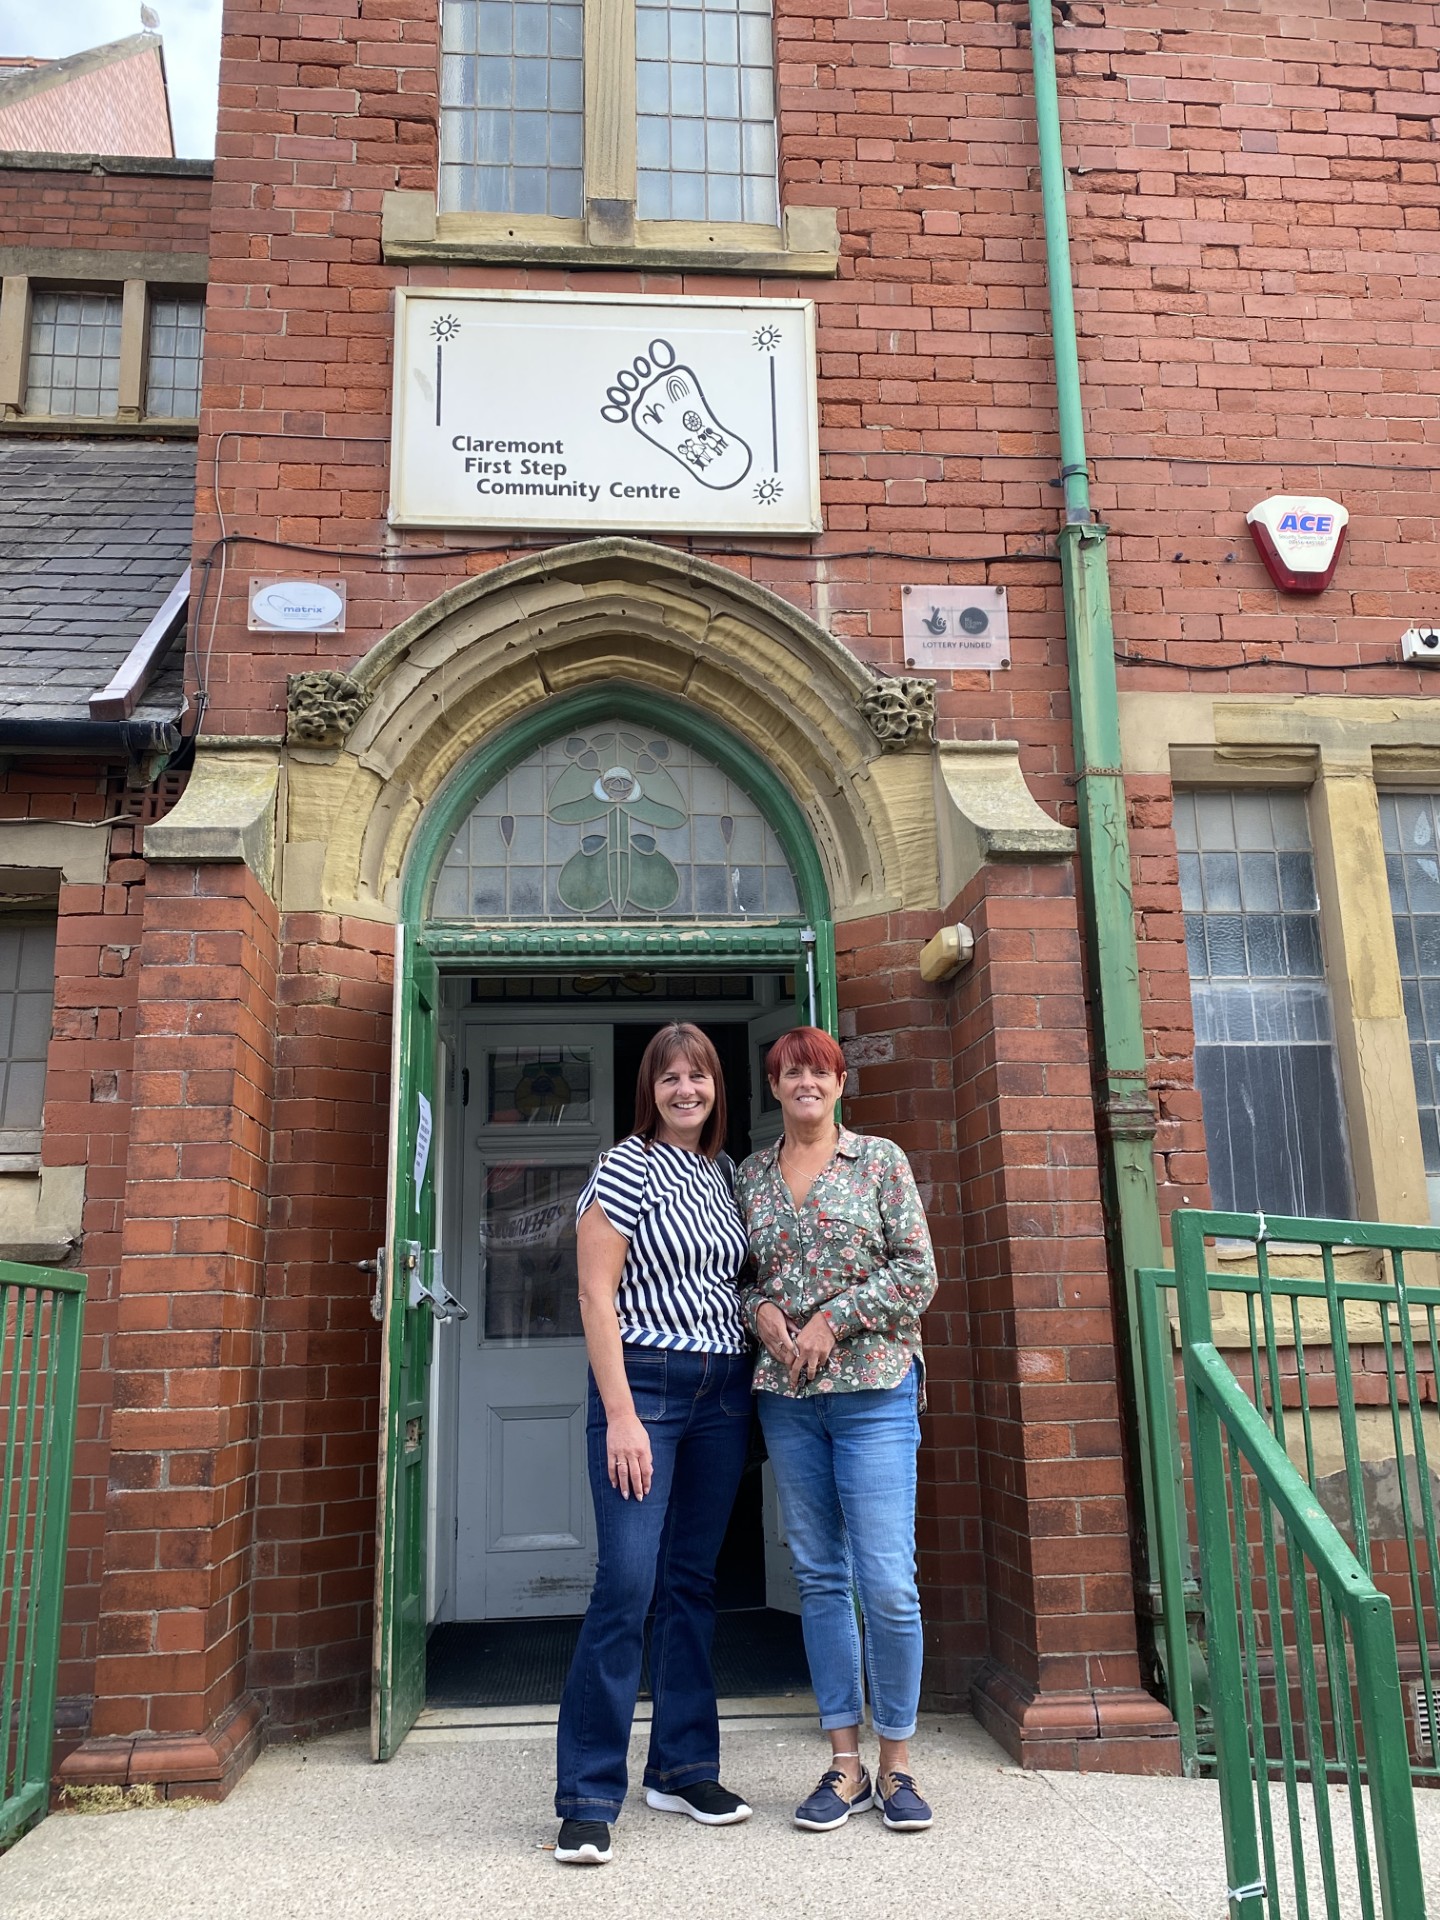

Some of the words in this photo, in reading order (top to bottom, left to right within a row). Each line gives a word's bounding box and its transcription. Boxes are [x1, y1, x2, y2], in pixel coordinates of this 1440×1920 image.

[453, 435, 563, 454] Claremont
[465, 457, 512, 474] First
[520, 458, 567, 479] Step
[477, 477, 601, 502] Community
[609, 481, 681, 499] Centre
[1279, 515, 1331, 531] ACE
[284, 604, 322, 613] matrix
